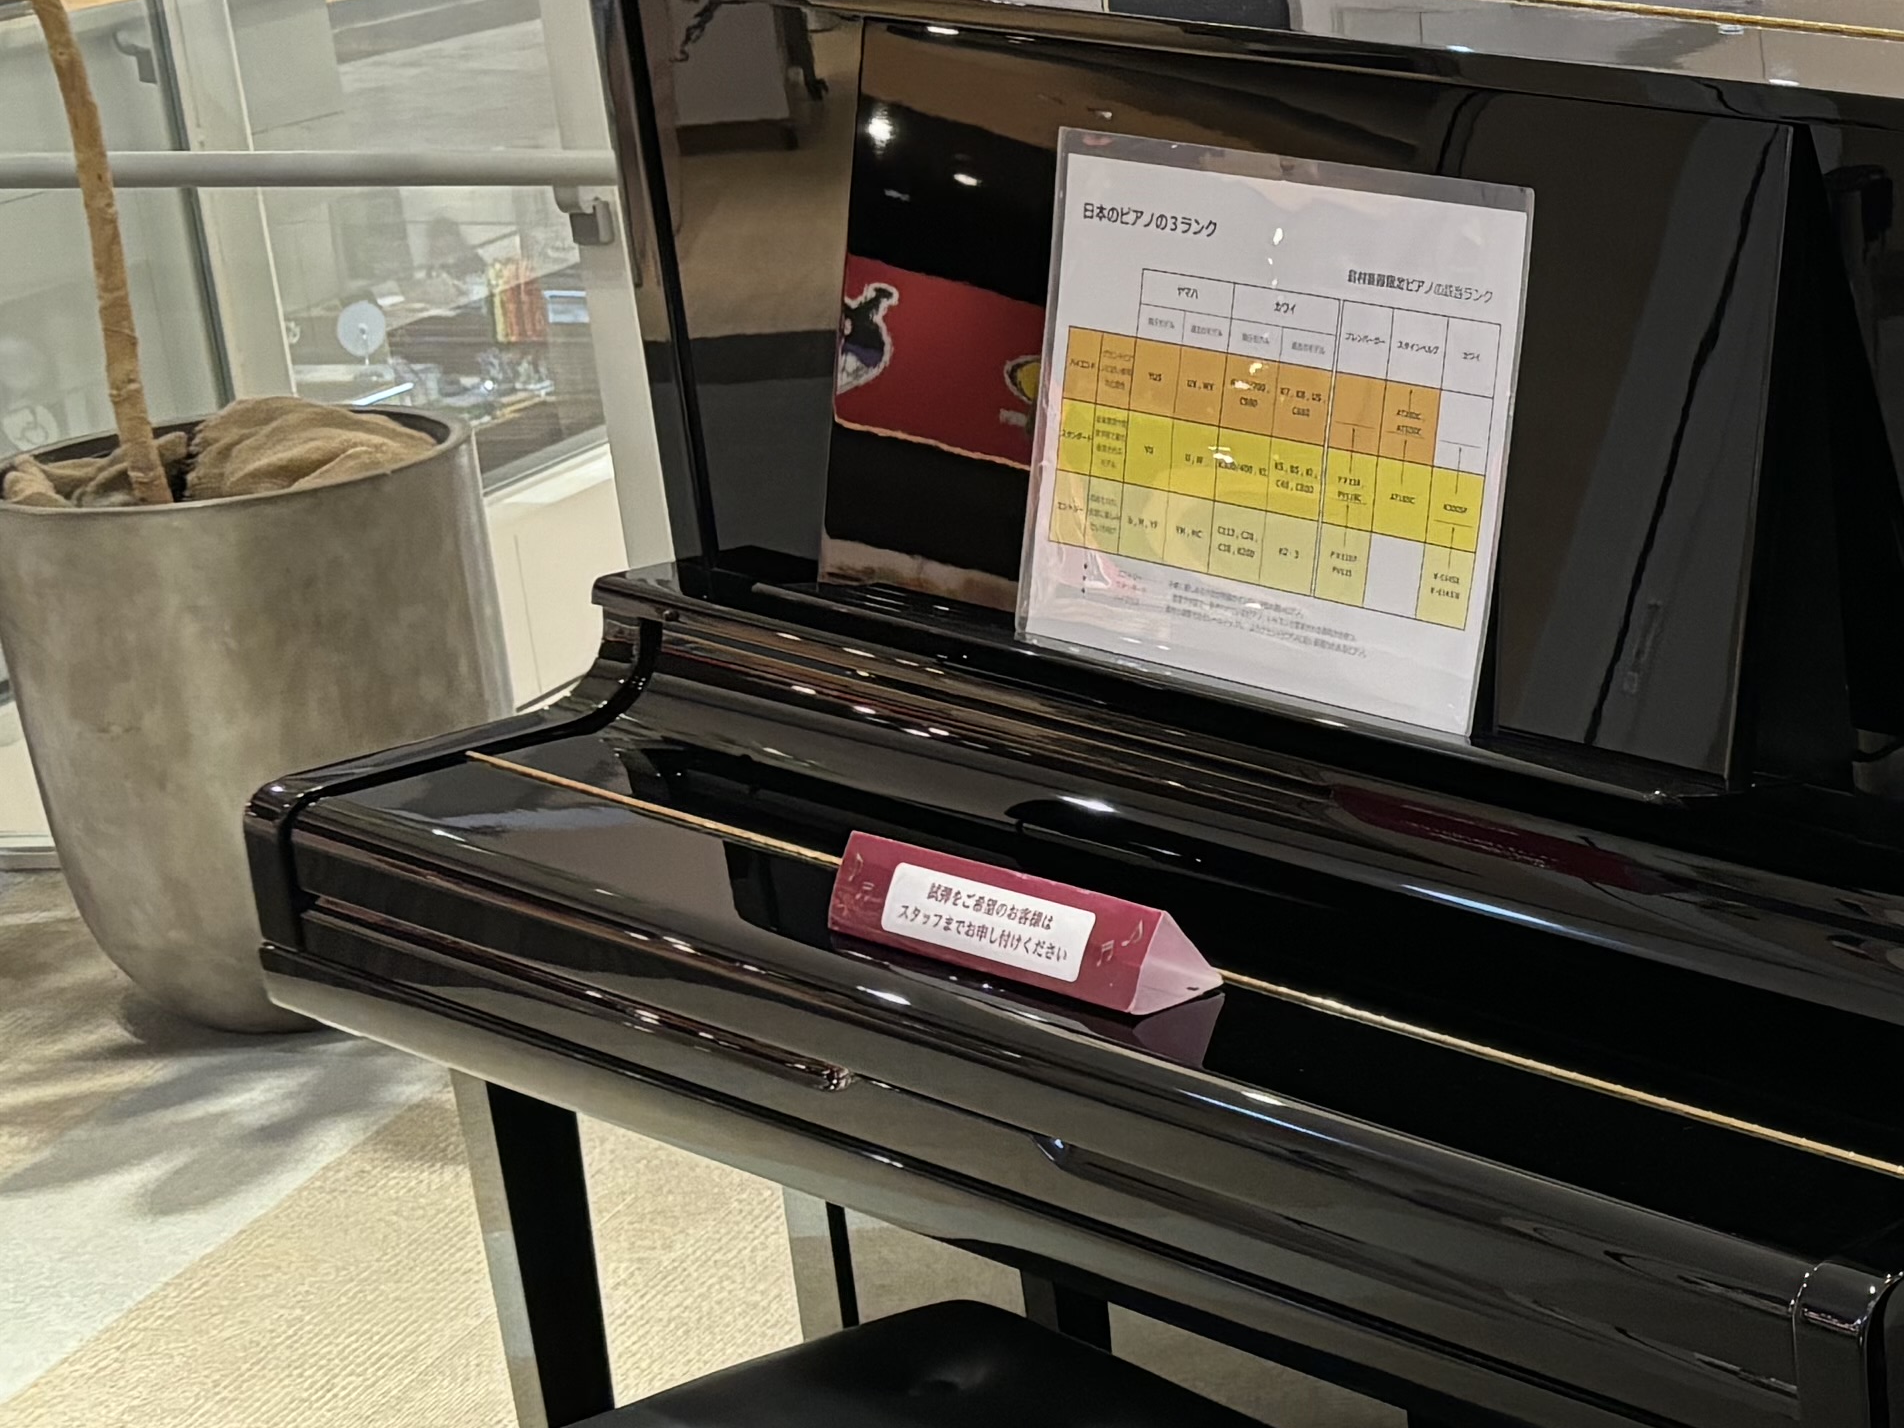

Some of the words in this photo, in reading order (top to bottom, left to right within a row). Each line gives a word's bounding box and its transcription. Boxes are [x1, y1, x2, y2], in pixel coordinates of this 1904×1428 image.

[1083, 202, 1218, 238] 日本のピアノの3ランク
[1176, 286, 1200, 300] ヤマハ
[1273, 300, 1297, 314] カワイ
[927, 881, 1055, 930] 試弾をご希望のお客様は
[897, 904, 1068, 962] スタッフまでお申し付けください
